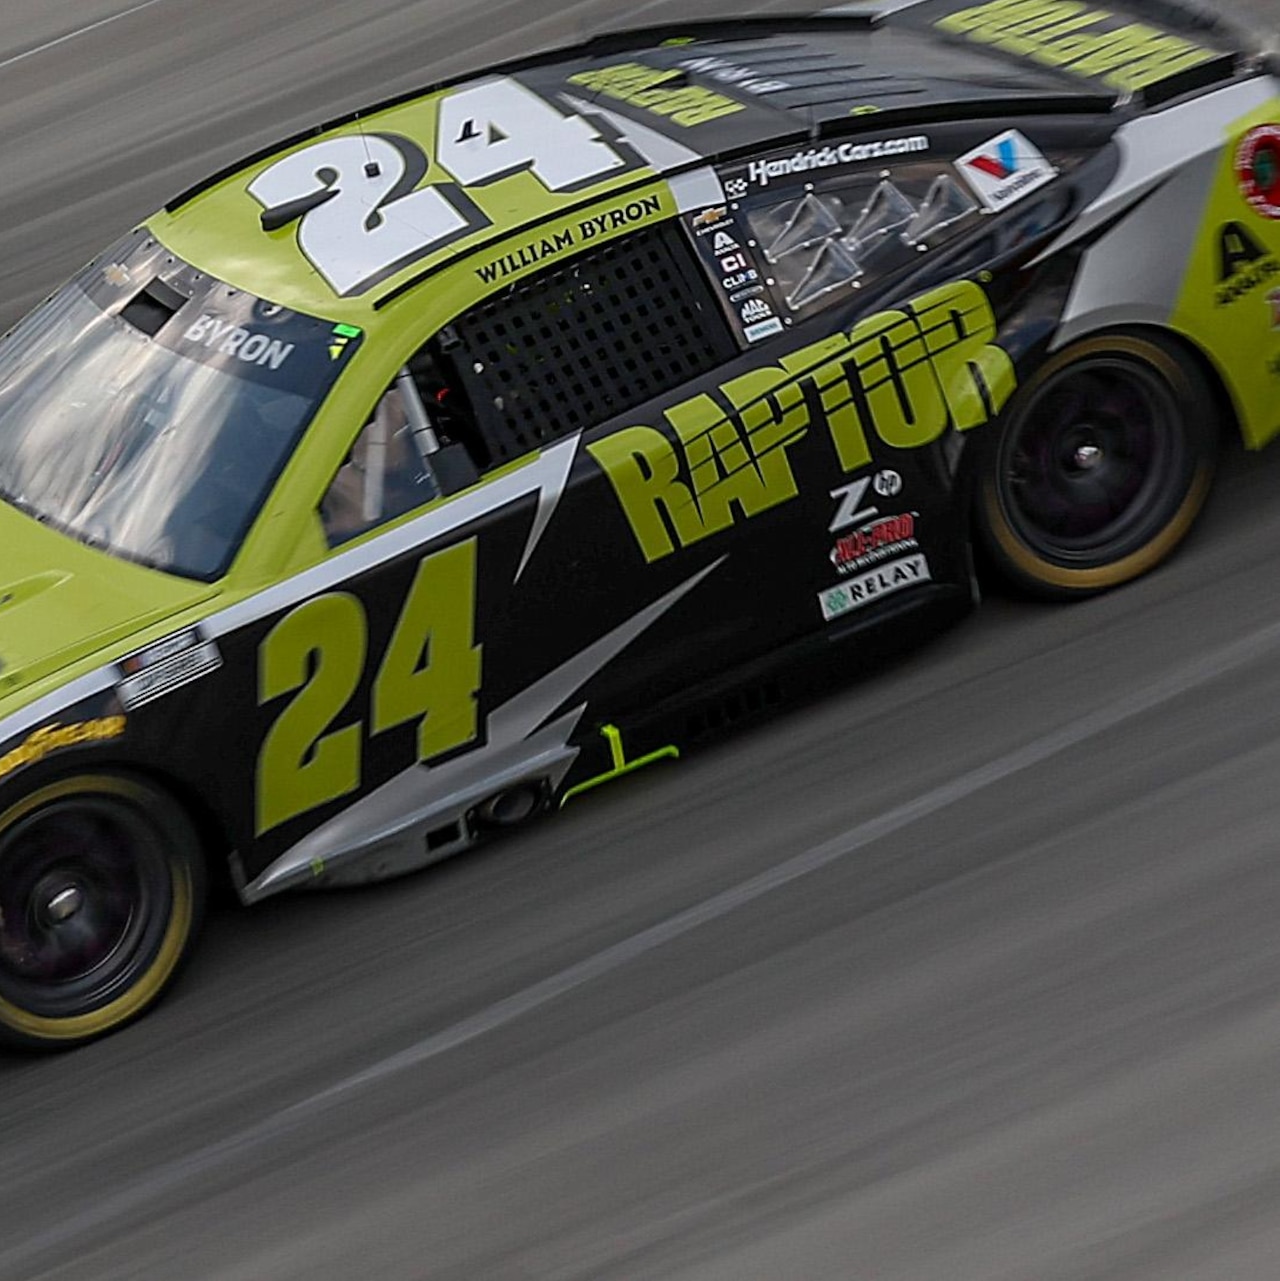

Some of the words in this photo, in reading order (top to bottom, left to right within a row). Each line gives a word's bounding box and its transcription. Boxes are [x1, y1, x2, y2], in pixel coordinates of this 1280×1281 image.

[245, 75, 630, 297] 24
[748, 135, 929, 186] HendrickCars.com
[475, 228, 575, 284] WILLIAM
[578, 195, 662, 241] BYRON
[183, 314, 295, 370] BYRON
[585, 279, 1018, 563] RAPTOR
[849, 560, 921, 602] RELAY
[255, 535, 483, 838] 24
